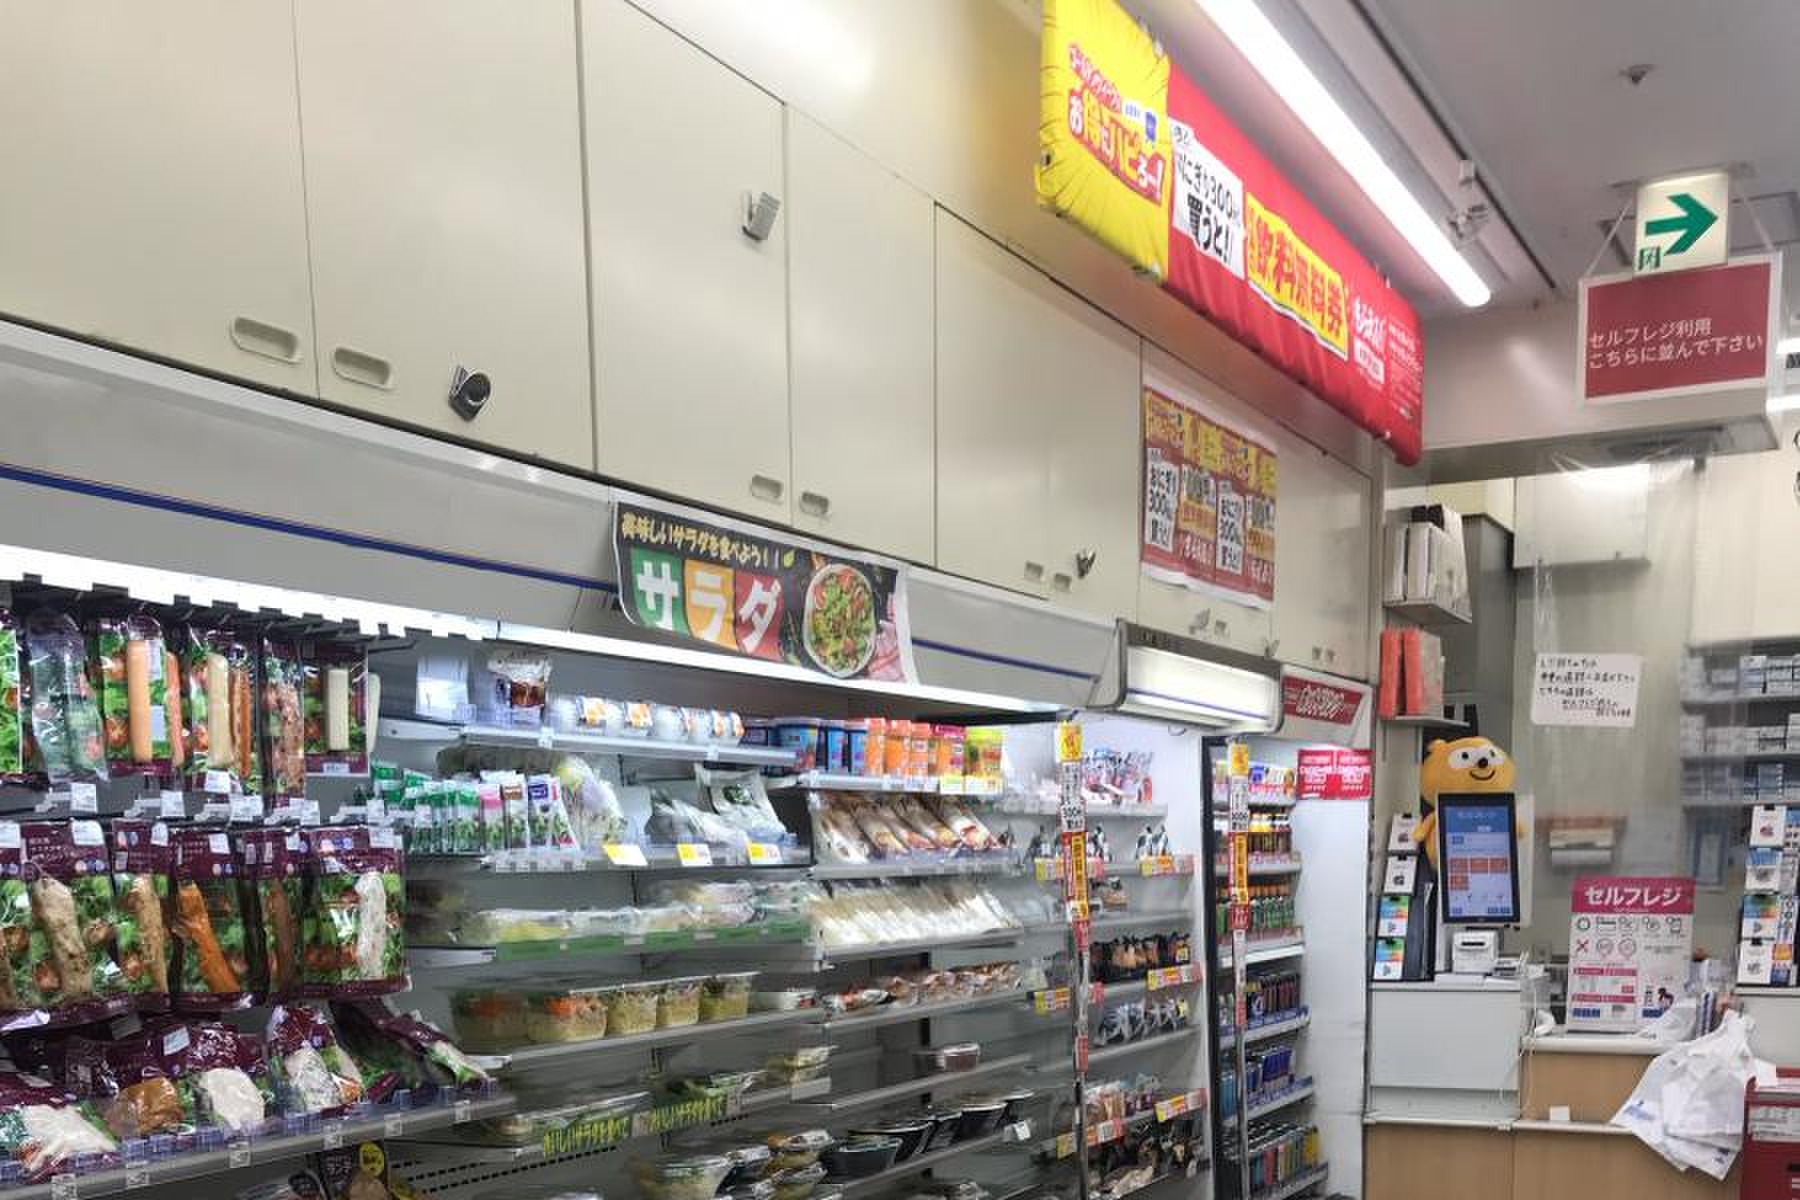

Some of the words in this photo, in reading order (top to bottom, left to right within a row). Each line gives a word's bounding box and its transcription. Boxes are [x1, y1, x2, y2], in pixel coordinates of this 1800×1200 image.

[1589, 318, 1713, 350] セルフレジ利用
[1588, 334, 1763, 369] こちらに並んで下さい
[635, 558, 783, 653] サラダ
[1585, 886, 1682, 907] セルフレジ
